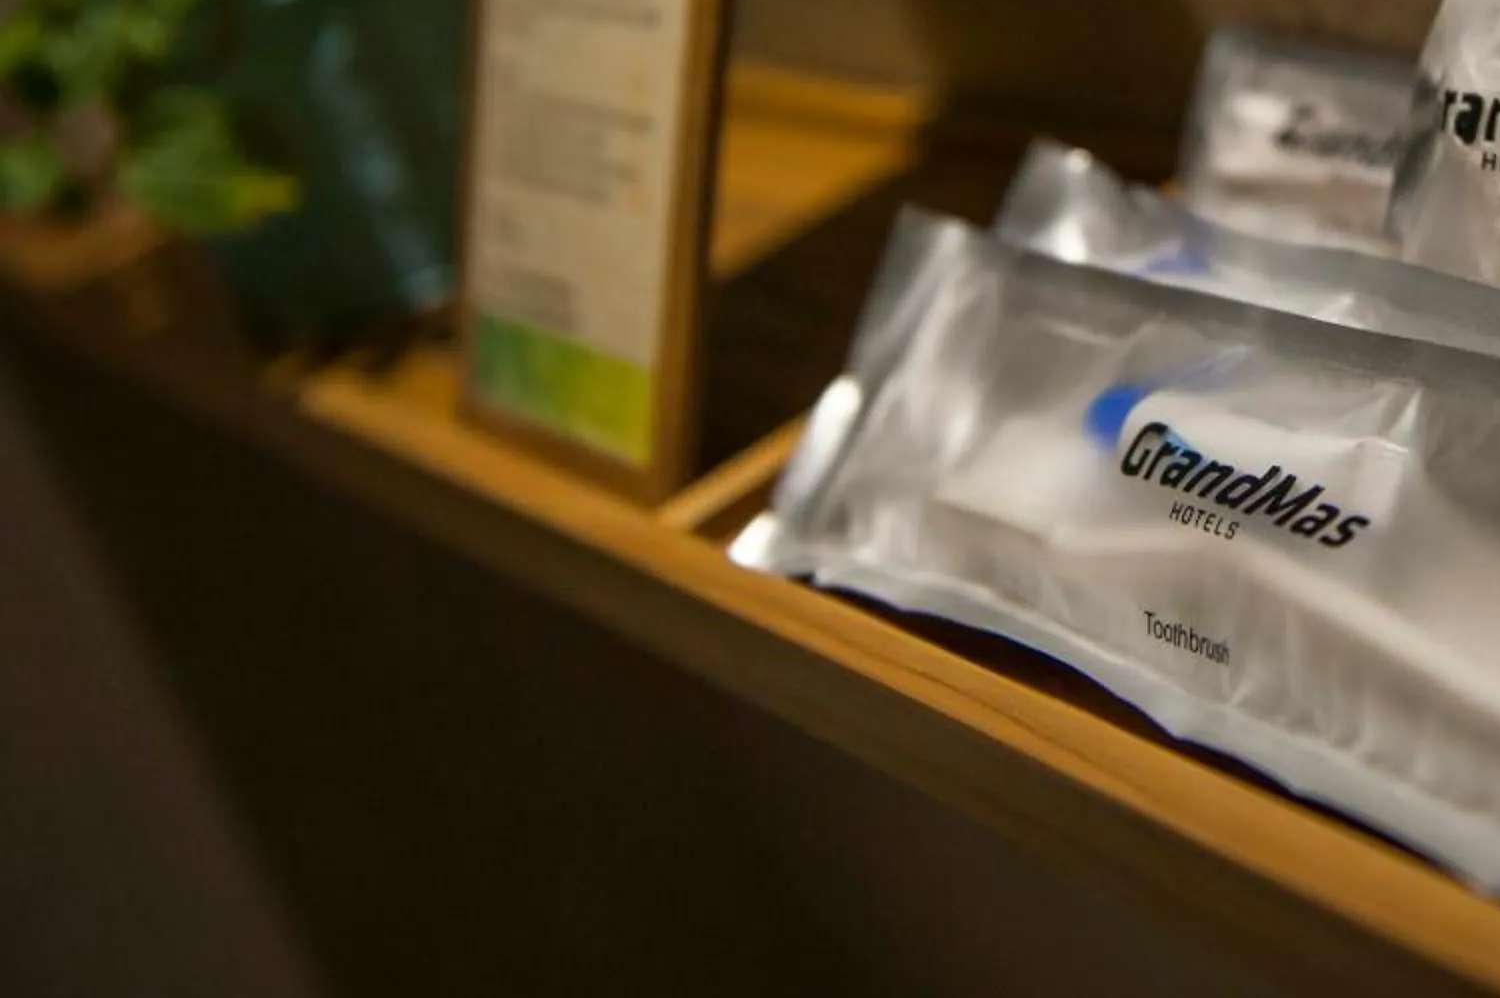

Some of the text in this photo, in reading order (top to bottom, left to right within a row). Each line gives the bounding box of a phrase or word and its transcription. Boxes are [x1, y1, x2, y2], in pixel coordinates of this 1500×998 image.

[1119, 421, 1371, 548] GrandMas
[1168, 500, 1240, 541] HOTELS
[1143, 609, 1232, 667] Toothbrush
